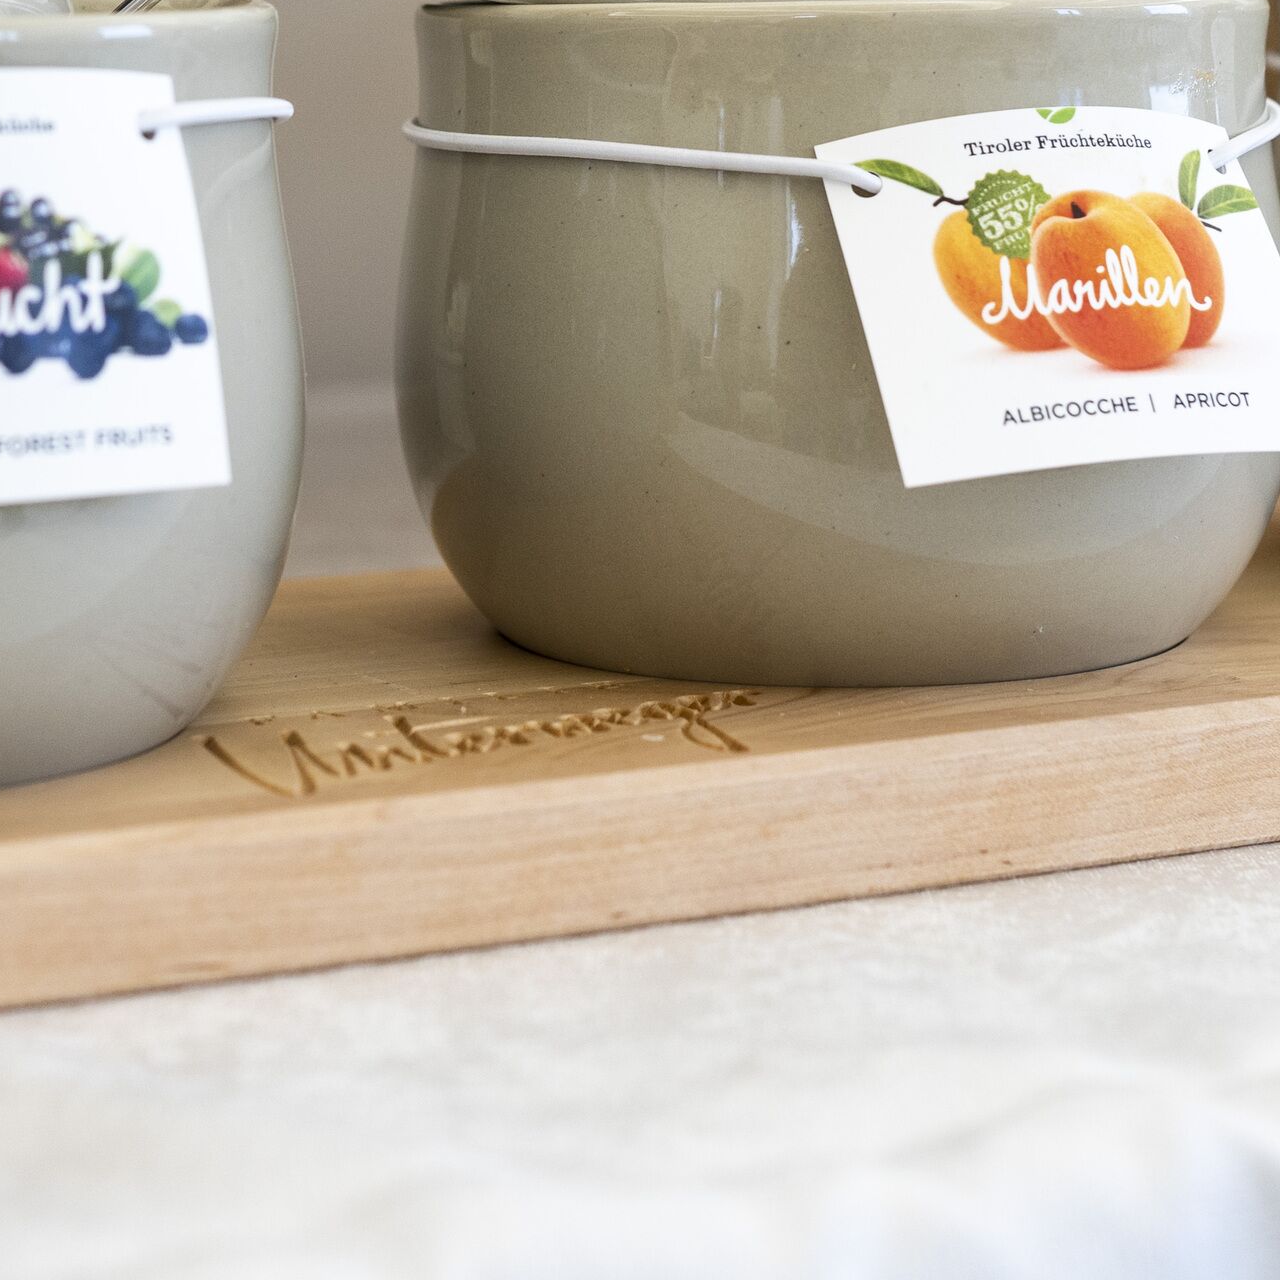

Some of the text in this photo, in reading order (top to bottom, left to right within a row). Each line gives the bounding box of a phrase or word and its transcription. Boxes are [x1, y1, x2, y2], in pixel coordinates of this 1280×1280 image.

[964, 133, 1152, 156] Tiroler Früchteküche
[972, 182, 1032, 216] FRUCHT
[981, 245, 1212, 324] Marillen
[1003, 391, 1251, 425] ALBICOCCHE APRICOT
[94, 423, 175, 450] FRUITS
